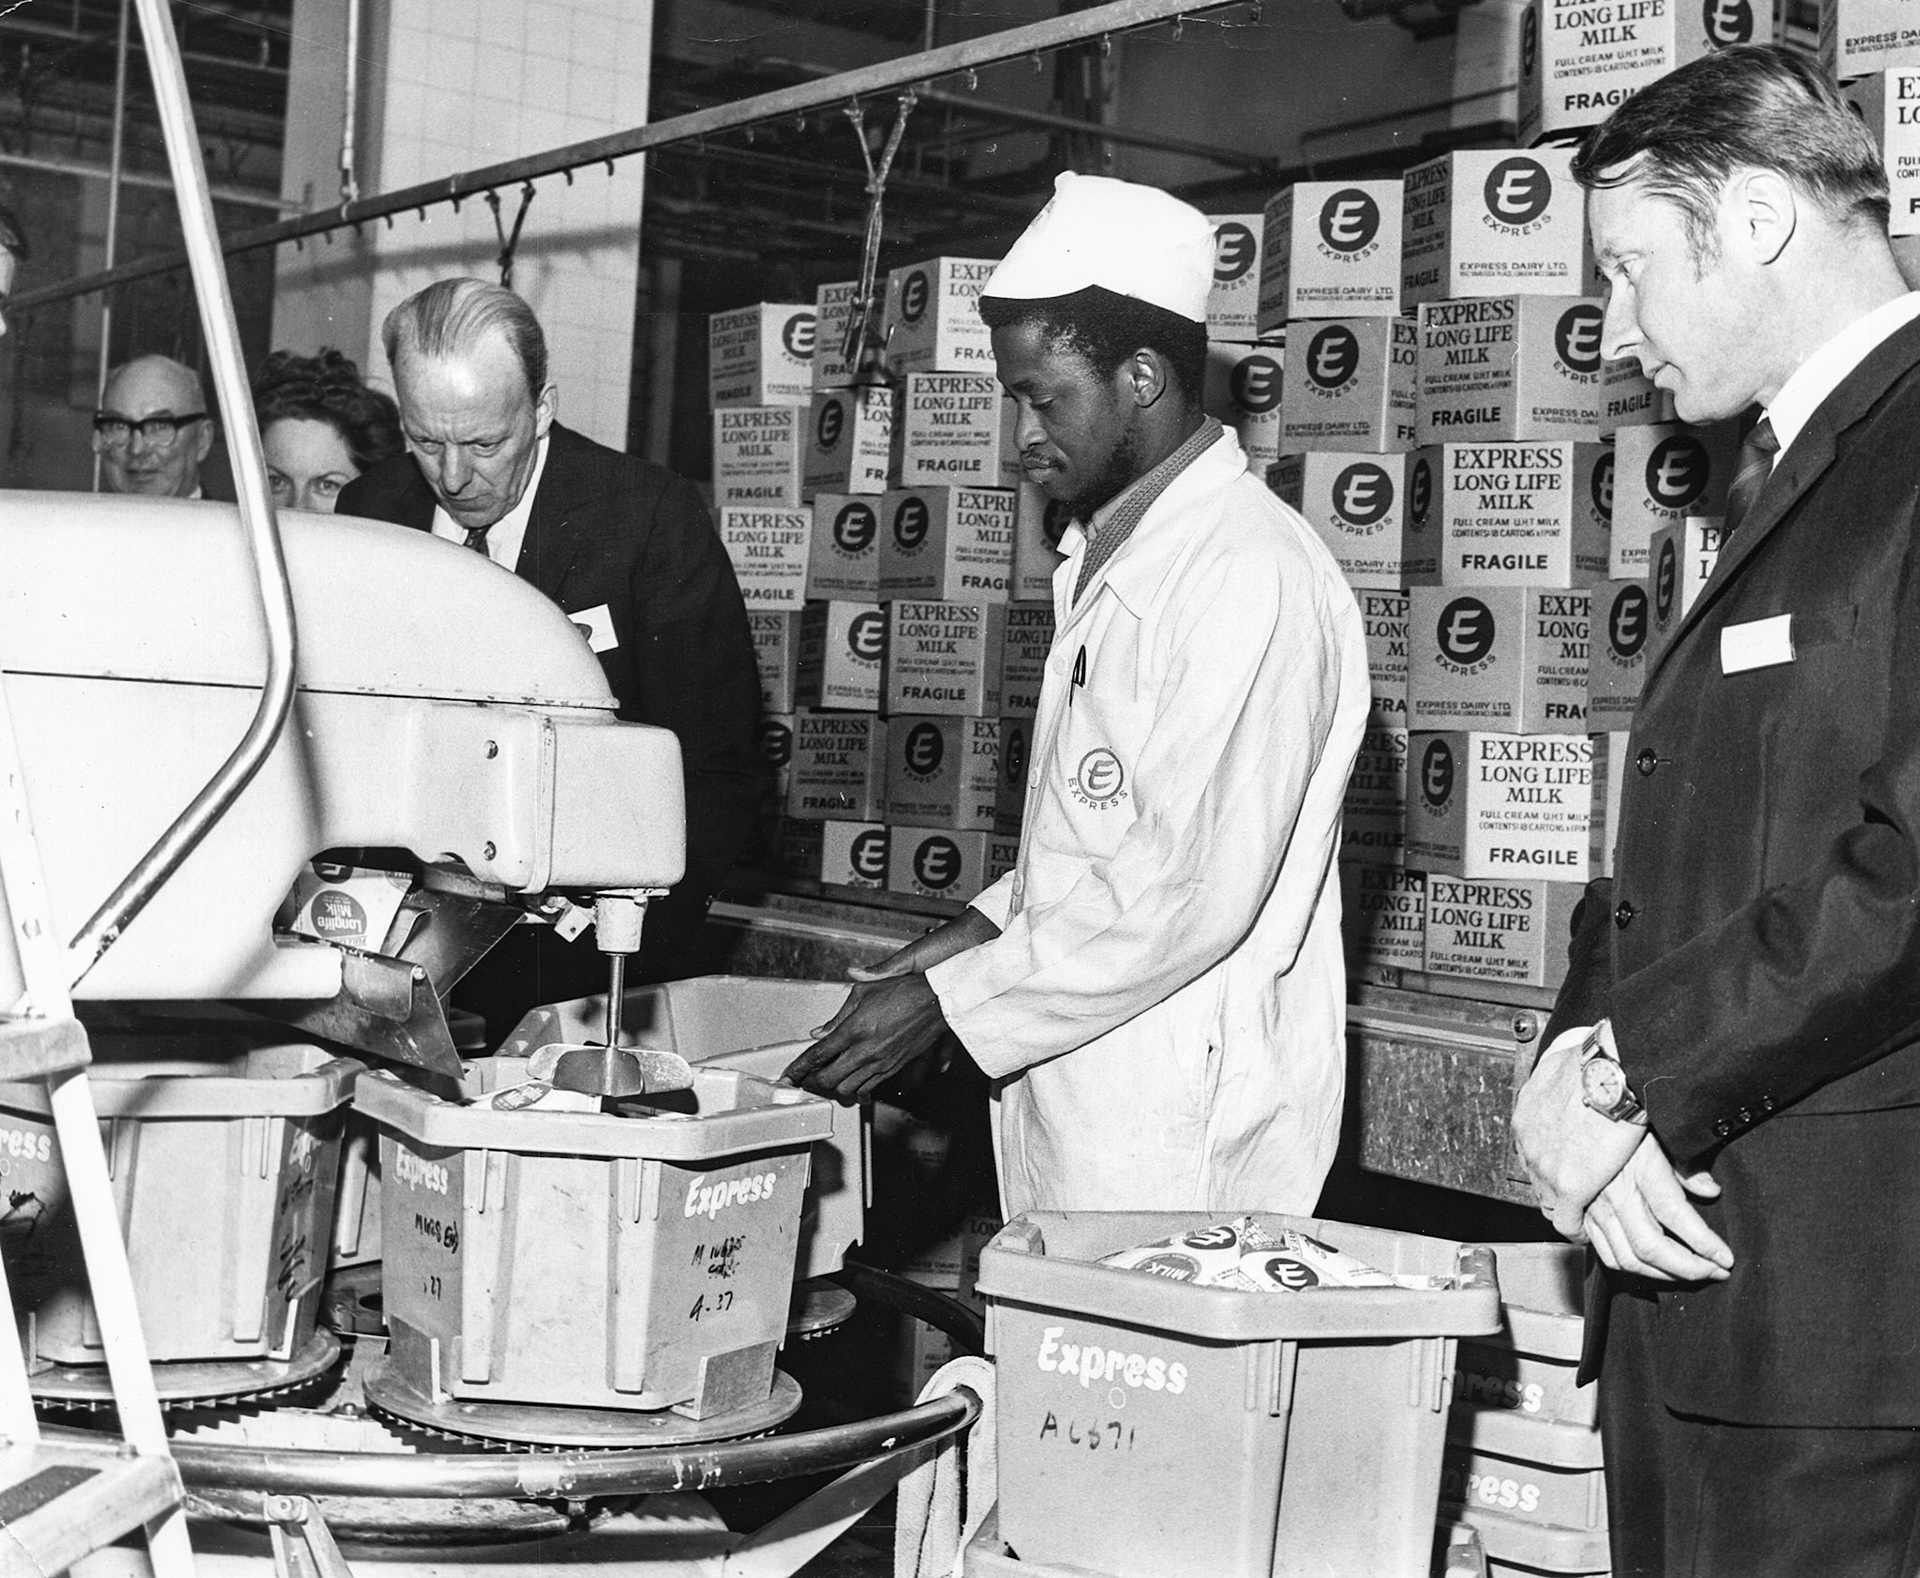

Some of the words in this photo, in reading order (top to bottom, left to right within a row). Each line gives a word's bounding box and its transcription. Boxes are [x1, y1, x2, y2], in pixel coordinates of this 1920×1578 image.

[1554, 6, 1612, 30] LONG
[1617, 0, 1665, 22] LIFE
[1579, 24, 1637, 47] MILK
[1845, 31, 1897, 47] EXPRESS
[1555, 58, 1576, 67] FULL
[1578, 52, 1613, 64] CREAM
[1641, 46, 1664, 56] MILK
[1482, 213, 1552, 236] EXPRESS
[1317, 241, 1380, 263] EXPRESS
[1460, 262, 1508, 270] EXPRESS
[1512, 262, 1544, 270] DAIRY
[1297, 287, 1339, 295] EXPRESS
[1343, 287, 1372, 295] DAIRY
[1425, 299, 1515, 327] EXPRESS
[1425, 330, 1471, 348] LONG
[1474, 324, 1513, 344] LIFE
[1444, 347, 1490, 366] MILK
[914, 377, 994, 393] EXPRESS
[1304, 377, 1358, 399] EXPRESS
[913, 397, 954, 410] LONG
[958, 397, 993, 410] LIFE
[1533, 407, 1577, 417] EXPRESS
[1607, 392, 1652, 417] FRAGILE
[722, 411, 791, 428] EXPRESS
[931, 413, 971, 425] MILK
[1432, 406, 1501, 426] FRAGILE
[1286, 422, 1322, 431] EXPRESS
[1325, 422, 1350, 431] DAIRY
[722, 430, 757, 443] LONG
[761, 430, 790, 441] LIFE
[738, 445, 773, 456] MILK
[1453, 448, 1563, 469] EXPRESS
[918, 460, 981, 472] FRAGILE
[1453, 474, 1510, 491] LONG
[1515, 473, 1562, 490] LIFE
[727, 487, 783, 499] FRAGILE
[1477, 494, 1534, 510] MILK
[728, 513, 805, 529] EXPRESS
[957, 512, 999, 528] LONG
[1329, 514, 1394, 536] EXPRESS
[1453, 518, 1473, 527] FULL
[1475, 518, 1510, 527] CREAM
[1537, 518, 1560, 526] MILK
[728, 531, 768, 543] LONG
[771, 532, 804, 544] LIFE
[745, 546, 784, 558] MILK
[1461, 554, 1549, 570] FRAGILE
[900, 604, 979, 621] EXPRESS
[899, 624, 940, 637] LONG
[944, 625, 978, 639] LIFE
[1537, 620, 1589, 639] LONG
[916, 640, 957, 653] MILK
[1434, 653, 1496, 676] EXPRESS
[1537, 665, 1557, 675] FULL
[1559, 666, 1588, 675] CREAM
[902, 686, 966, 700] FRAGILE
[1416, 701, 1458, 710] EXPRESS
[1460, 701, 1490, 710] DAIRY
[800, 719, 869, 734] EXPRESS
[799, 738, 834, 750] LONG
[837, 738, 867, 750] LIFE
[1480, 740, 1593, 763] EXPRESS
[813, 752, 849, 764] MILK
[1480, 765, 1539, 784] LONG
[1545, 767, 1592, 786] LIFE
[1068, 777, 1128, 810] EXPRESS
[1505, 787, 1565, 804] MILK
[803, 797, 856, 809] FRAGILE
[1480, 810, 1502, 819] FULL
[1504, 811, 1539, 820] CREAM
[1567, 813, 1590, 821] MILK
[1489, 848, 1578, 865] FRAGILE
[1360, 893, 1411, 913] LONG
[1431, 882, 1533, 910] EXPRESS
[325, 903, 352, 918] Milk
[317, 916, 363, 933] Longlife
[1431, 907, 1483, 928] LONG
[1487, 912, 1530, 932] LIFE
[1453, 930, 1505, 950] MILK
[1430, 951, 1449, 961] FULL
[1451, 953, 1482, 964] CREAM
[1507, 958, 1529, 969] MILK
[393, 1142, 449, 1195] Express
[684, 1172, 777, 1221] Express
[1145, 1261, 1191, 1281] MILK
[1037, 1326, 1188, 1394] Express
